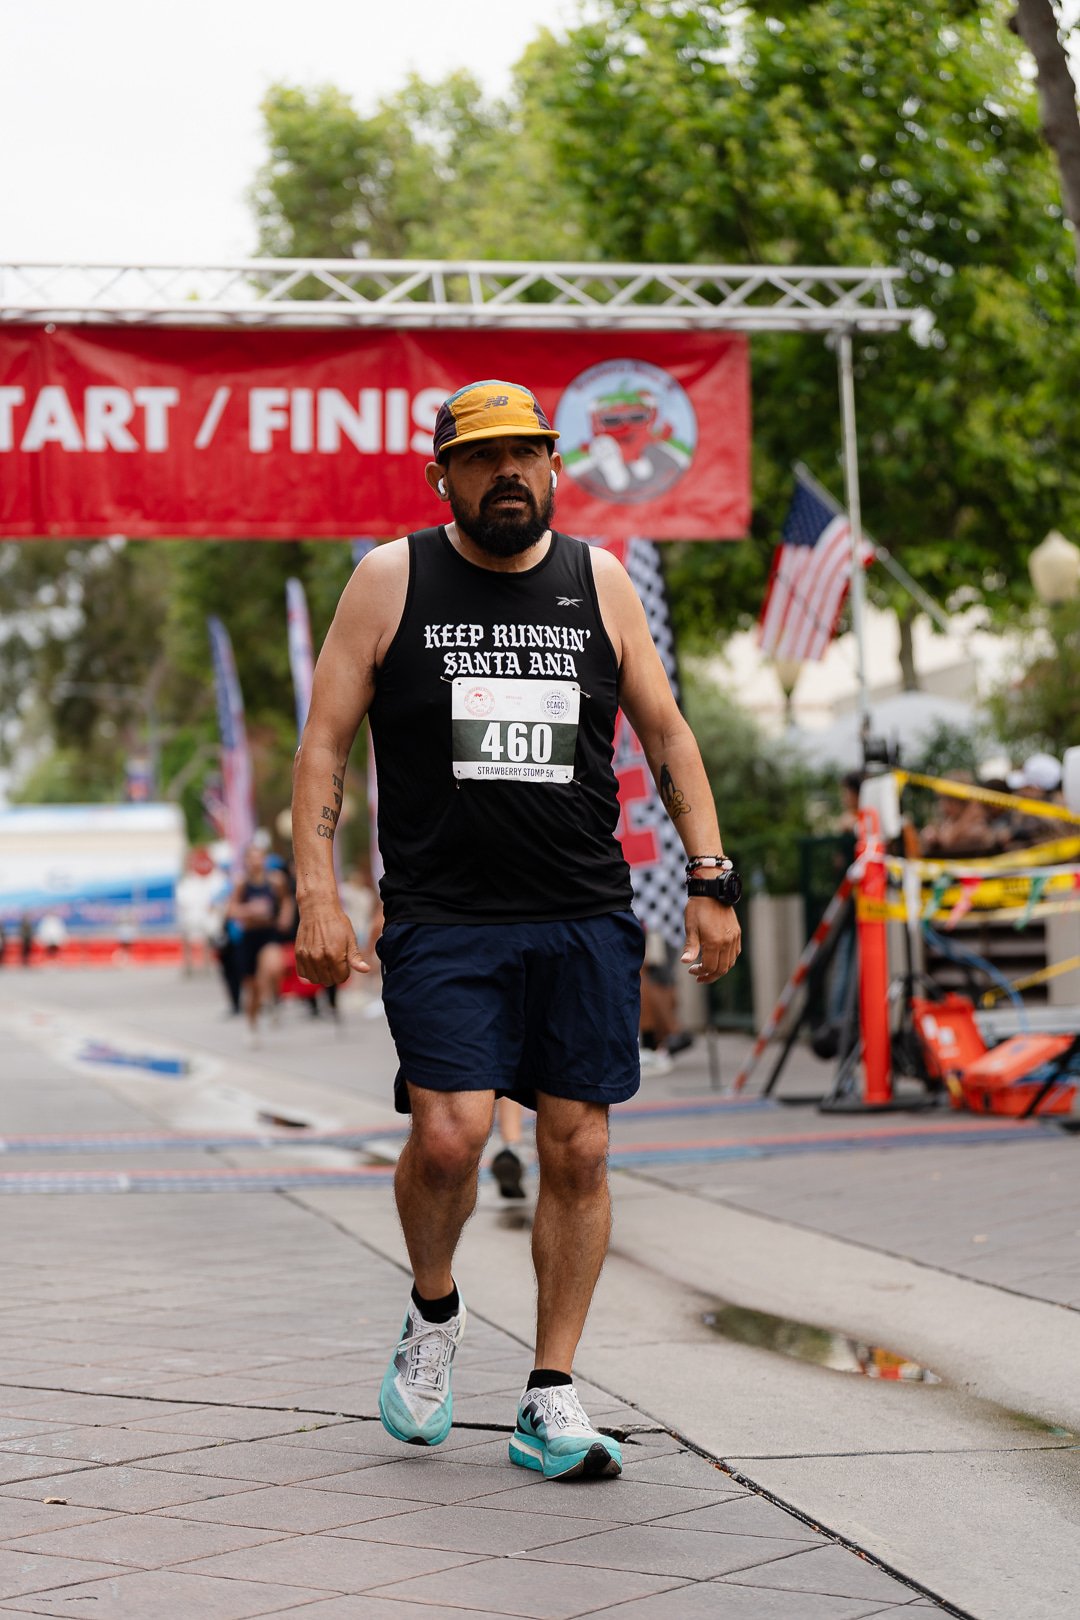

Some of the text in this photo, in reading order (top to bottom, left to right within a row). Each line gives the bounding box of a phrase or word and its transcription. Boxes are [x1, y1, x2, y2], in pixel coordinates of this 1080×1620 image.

[0, 386, 179, 453] TART
[249, 387, 447, 454] FINIS
[424, 624, 591, 653] KEEP RUNNIN'
[443, 651, 578, 678] SANTA ANA
[480, 721, 553, 764] 460
[477, 766, 555, 778] STRAWBERRY STOMP 5K
